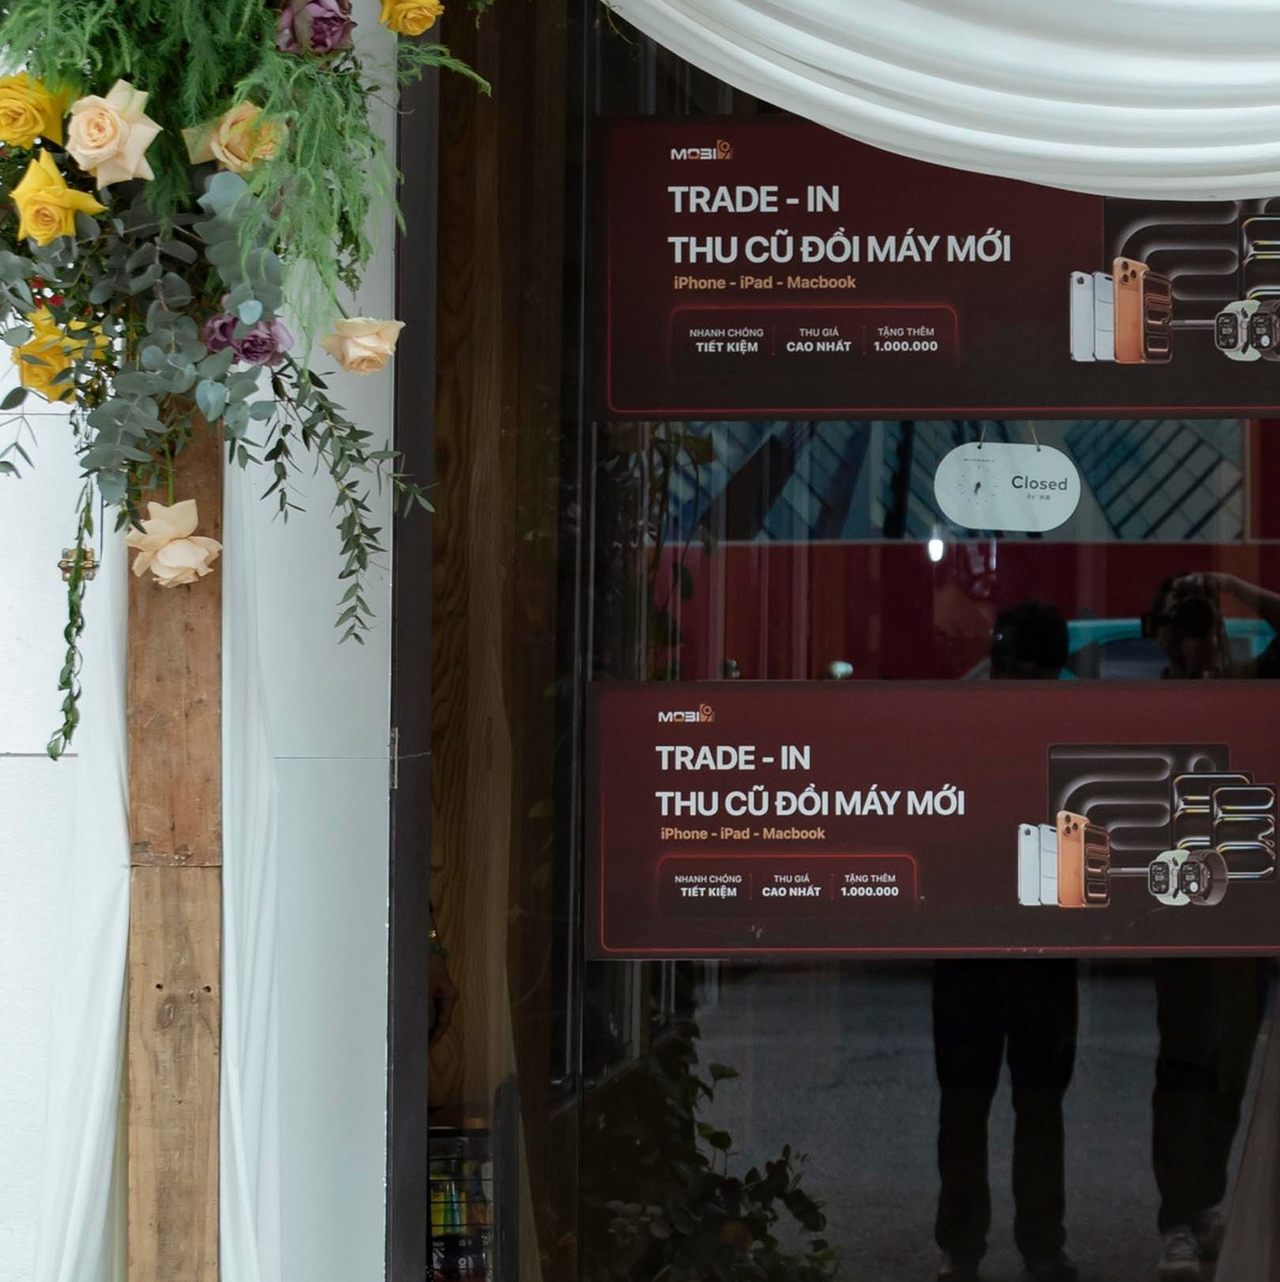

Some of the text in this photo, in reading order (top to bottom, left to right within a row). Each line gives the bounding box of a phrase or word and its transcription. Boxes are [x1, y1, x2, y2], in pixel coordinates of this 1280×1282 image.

[668, 185, 779, 213] TRADE
[807, 185, 840, 213] IN
[667, 226, 1011, 264] THU CŨ ĐỔI MÁY MỚI
[673, 275, 726, 290] iPhone
[740, 275, 773, 290] iPad
[787, 275, 856, 290] Macbook
[689, 327, 765, 338] NHANH CHÓNG
[799, 326, 839, 337] THU GIÁ
[877, 326, 935, 338] TẶNG THÊM
[696, 339, 759, 354] TIẾT KIỆM
[786, 340, 852, 352] CAO NHẤT
[873, 341, 938, 352] 1.000.000
[1011, 475, 1068, 491] Closed
[655, 745, 755, 770] TRADE
[781, 745, 811, 770] IN
[655, 782, 965, 816] THU CŨ ĐỔI MÁY MỚI
[660, 827, 708, 841] iPhone
[720, 827, 750, 841] iPad
[763, 827, 826, 841] Macbook
[675, 873, 742, 884] NHANH CHÓNG
[774, 873, 810, 883] THU GIÁ
[844, 873, 896, 885] TẶNG THÊM
[680, 885, 737, 899] TIẾT KIỆM
[762, 885, 822, 897] CAO NHẤT
[841, 887, 899, 897] 1.000.000
